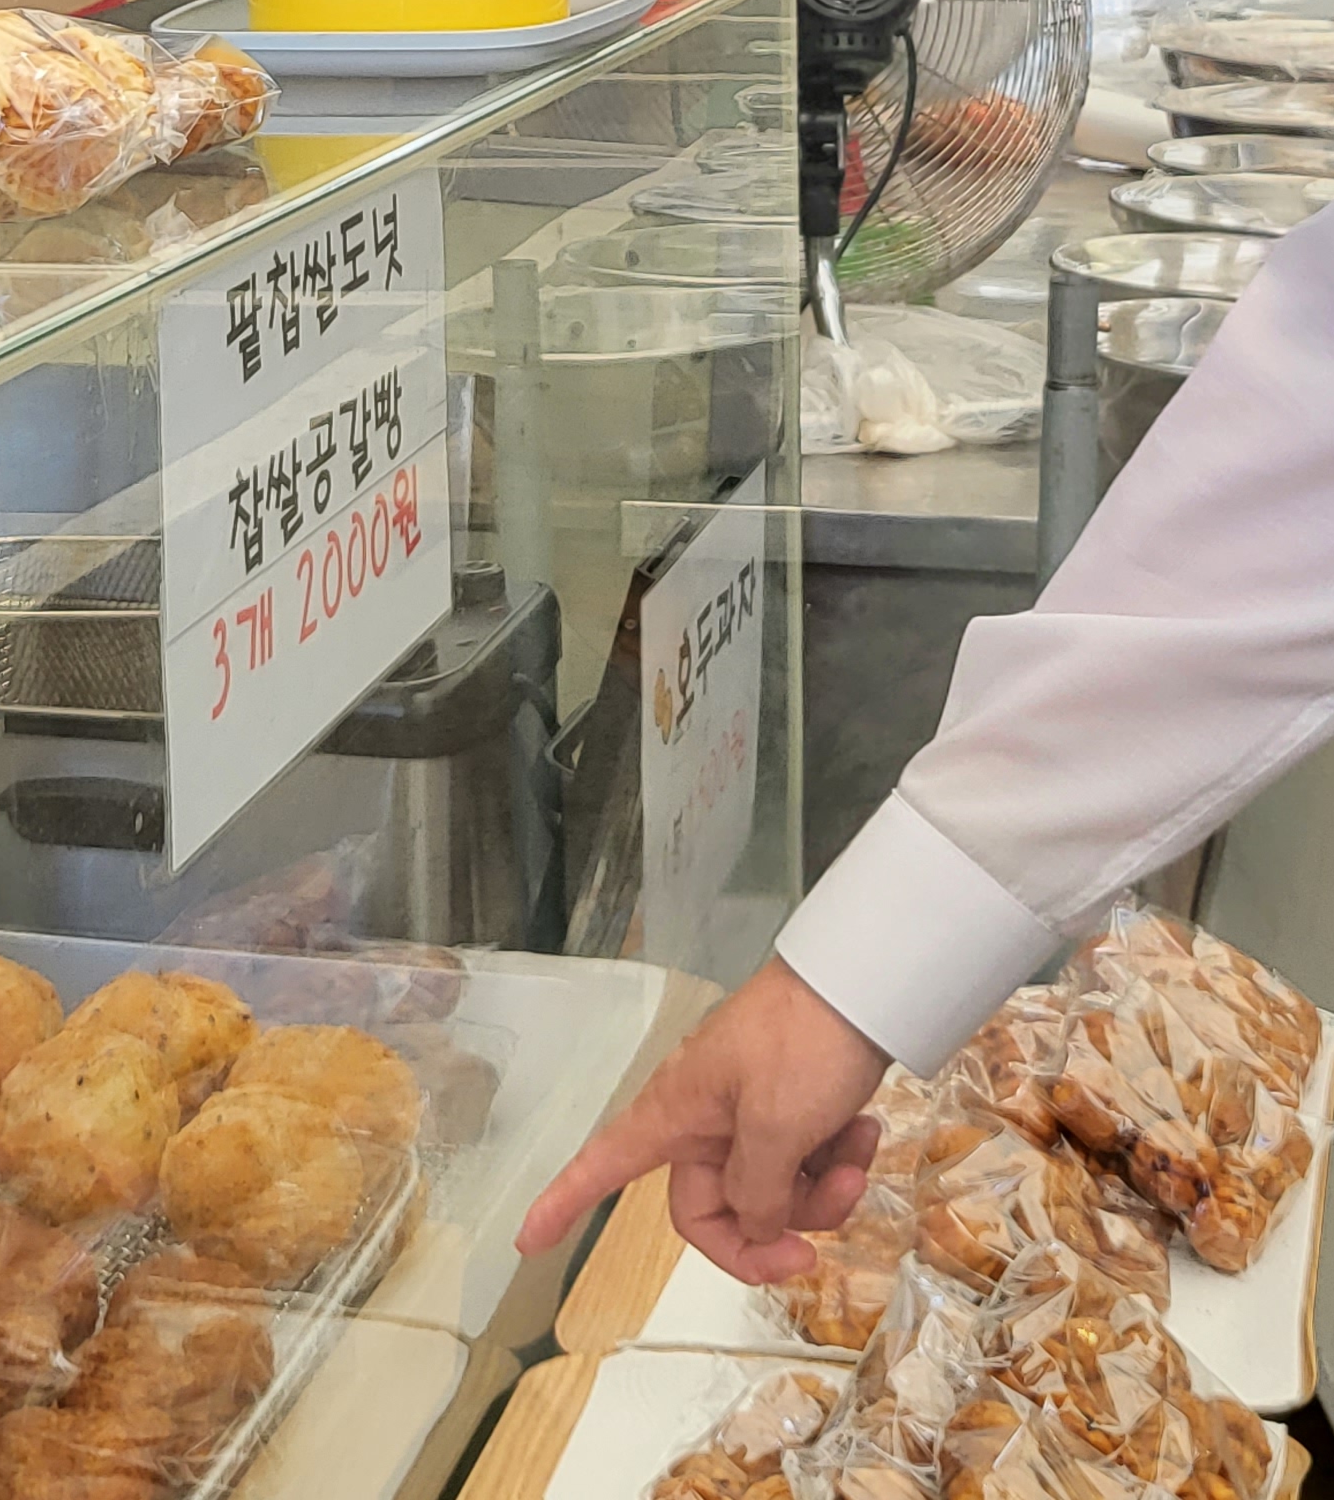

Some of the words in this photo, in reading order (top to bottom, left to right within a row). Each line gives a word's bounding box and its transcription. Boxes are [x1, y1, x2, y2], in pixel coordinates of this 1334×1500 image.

[226, 192, 404, 385] 팥찹쌀도넛
[227, 365, 404, 577] 찹쌀공갈빵
[211, 586, 275, 721] 3개
[297, 462, 424, 646] 2000원
